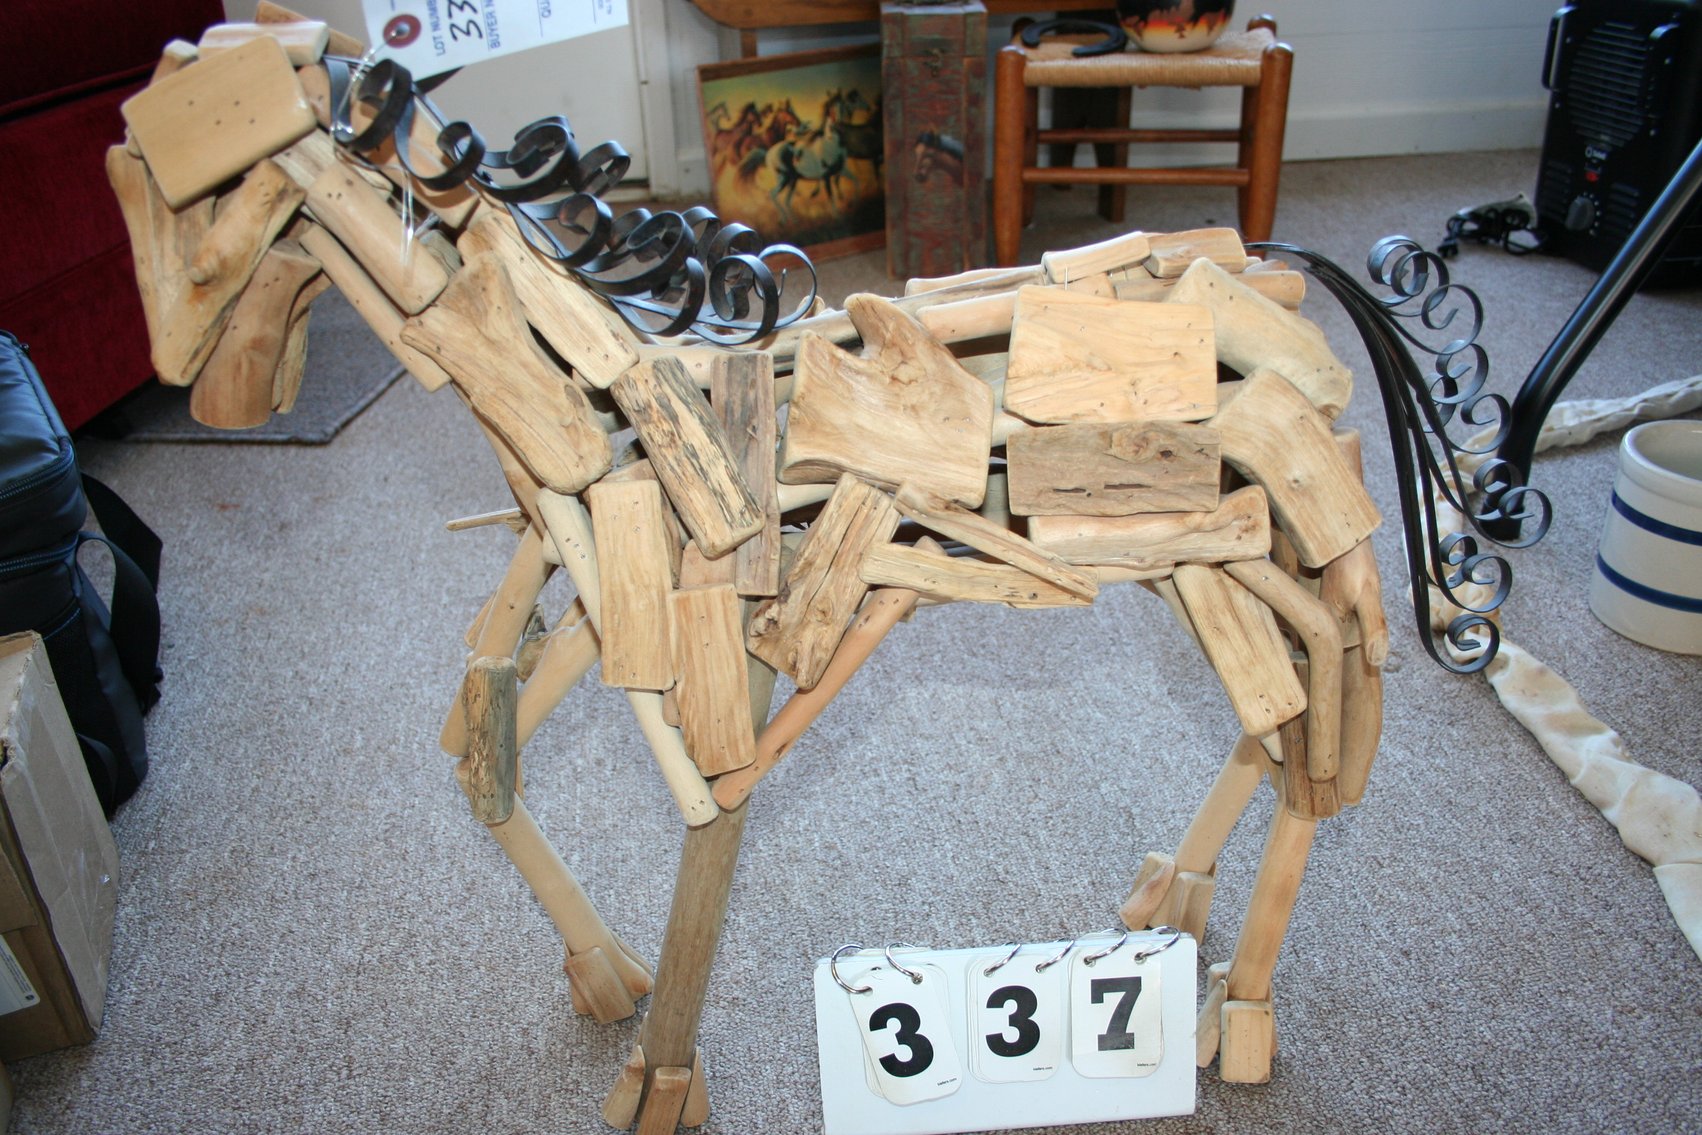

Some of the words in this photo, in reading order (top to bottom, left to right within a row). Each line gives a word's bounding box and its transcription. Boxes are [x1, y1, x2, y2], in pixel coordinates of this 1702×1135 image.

[447, 0, 483, 42] 33
[540, 0, 552, 18] QU
[433, 35, 446, 57] LOT
[485, 11, 501, 49] BUYER
[868, 1002, 935, 1078] 3
[985, 985, 1041, 1058] 3
[1090, 976, 1143, 1052] 7
